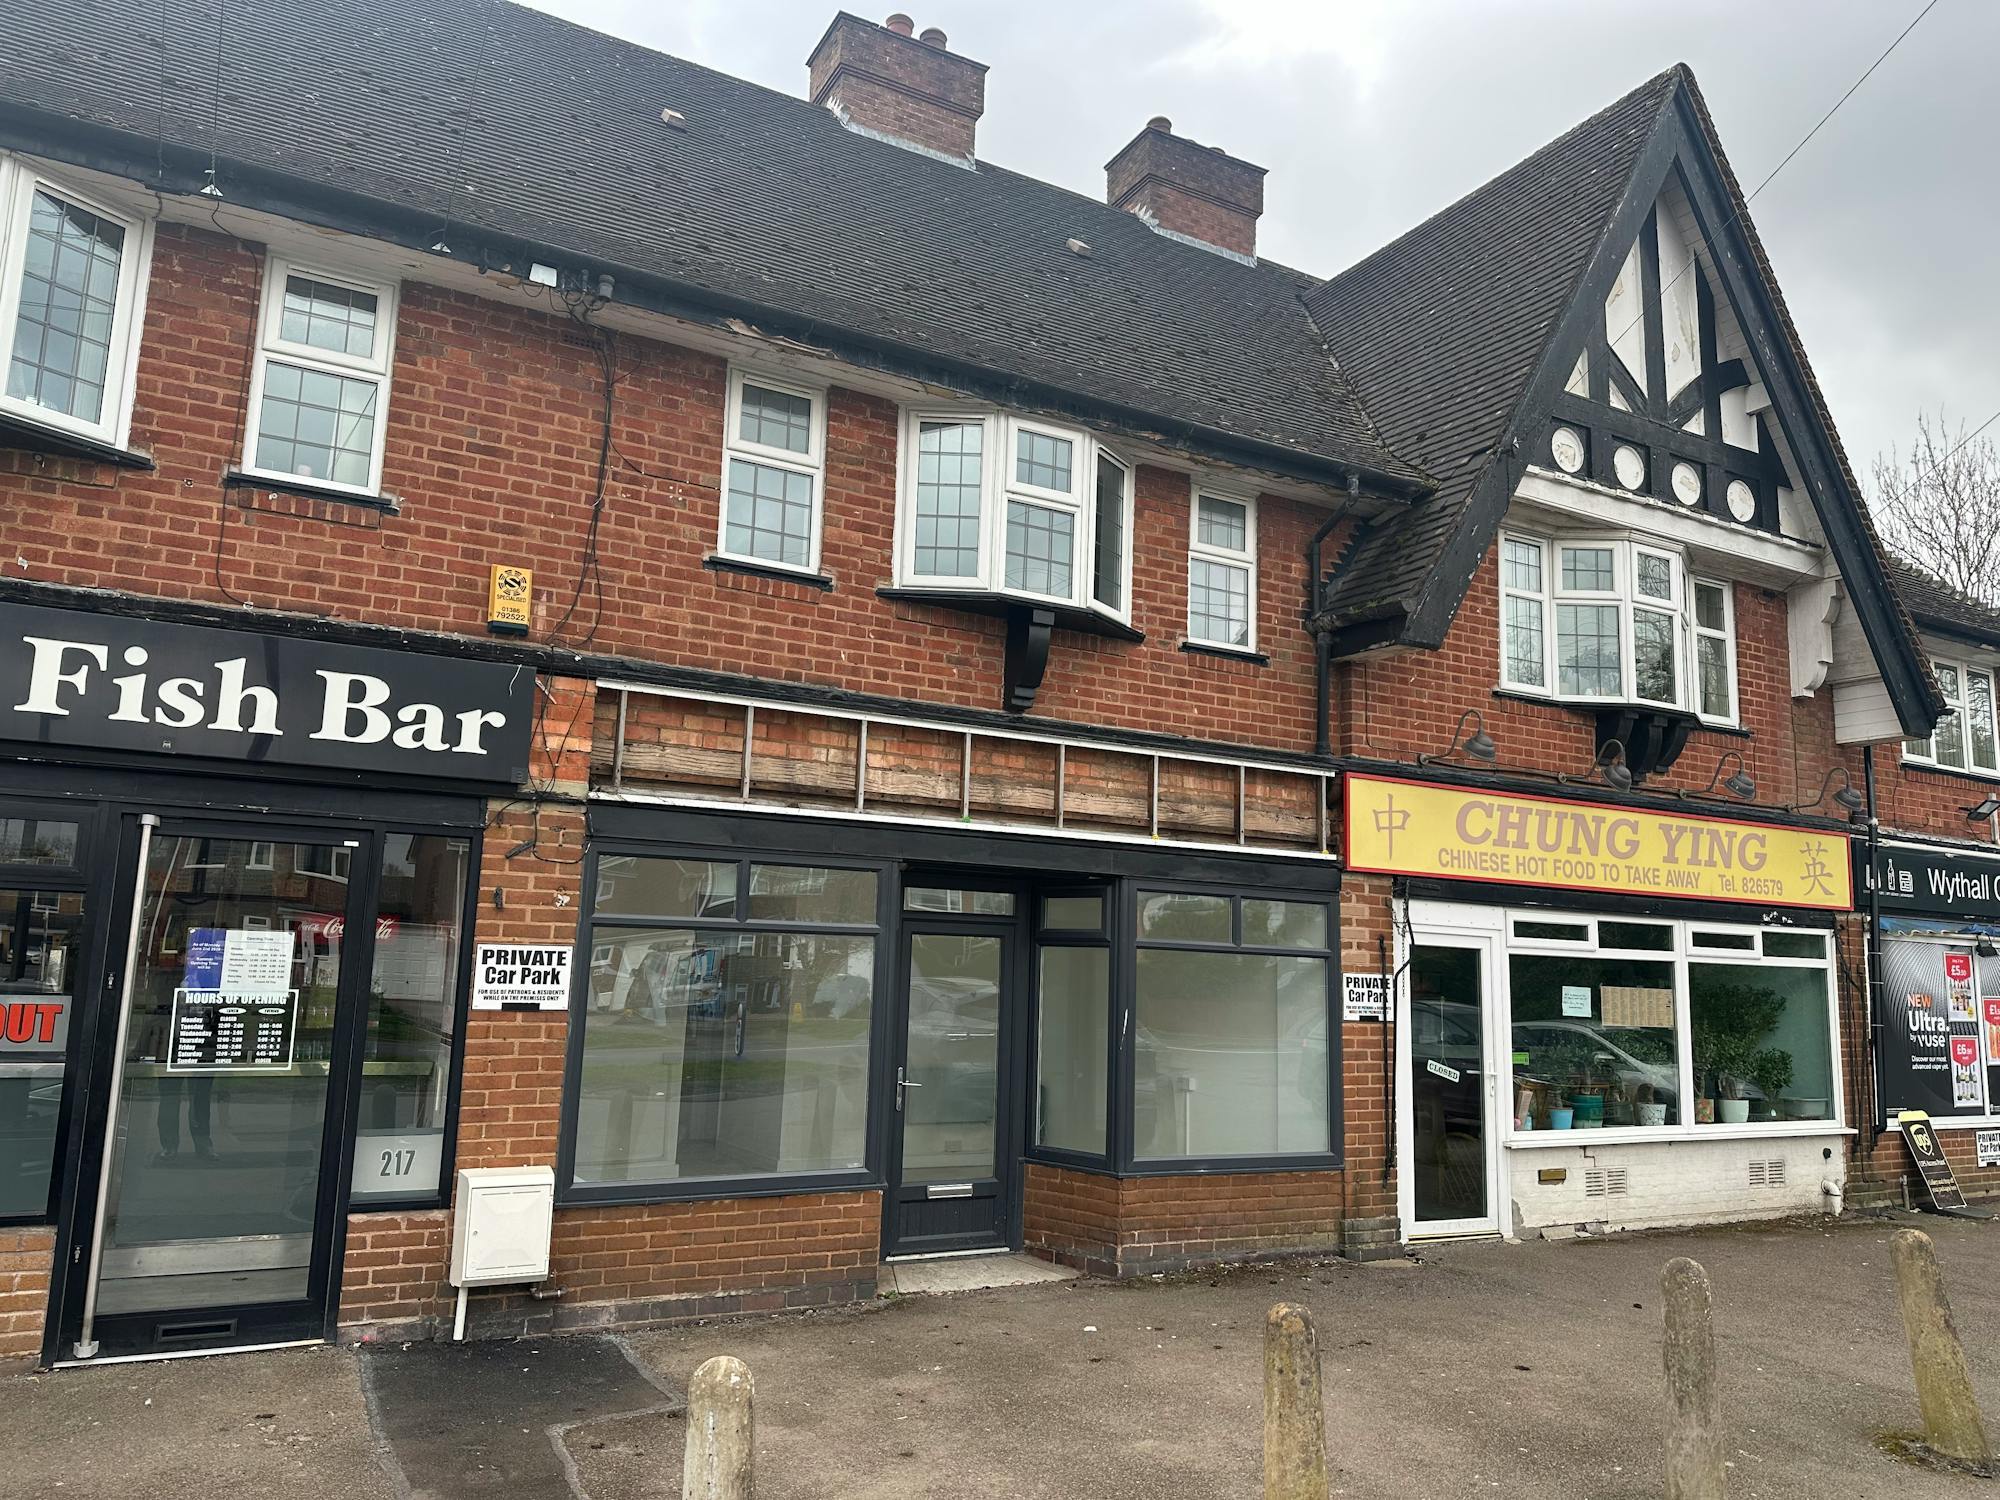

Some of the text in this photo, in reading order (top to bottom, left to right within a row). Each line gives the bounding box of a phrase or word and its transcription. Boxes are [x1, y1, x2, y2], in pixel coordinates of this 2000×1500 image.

[496, 594, 527, 603] SPECIALISED
[496, 611, 526, 621] 792522
[13, 635, 507, 755] Fish Bar
[1372, 793, 1411, 861] 中
[1456, 800, 1768, 872] CHUNG YING
[1438, 847, 1783, 897] CHINESE HOT FOOD TO TAKE AWAY Tel. 826579
[1799, 840, 1836, 897] 英
[1927, 868, 1990, 903] Wythall
[481, 949, 567, 966] PRIVATE
[485, 966, 561, 985] Car Park
[185, 992, 223, 1004] HOURS
[1349, 989, 1365, 1002] Car
[1907, 993, 1932, 1008] NEW
[1908, 1010, 1950, 1032] Ultra.
[1910, 1033, 1917, 1042] by
[1429, 1063, 1458, 1079] CLOSED
[1980, 1143, 1988, 1153] Car
[380, 1150, 416, 1177] 217
